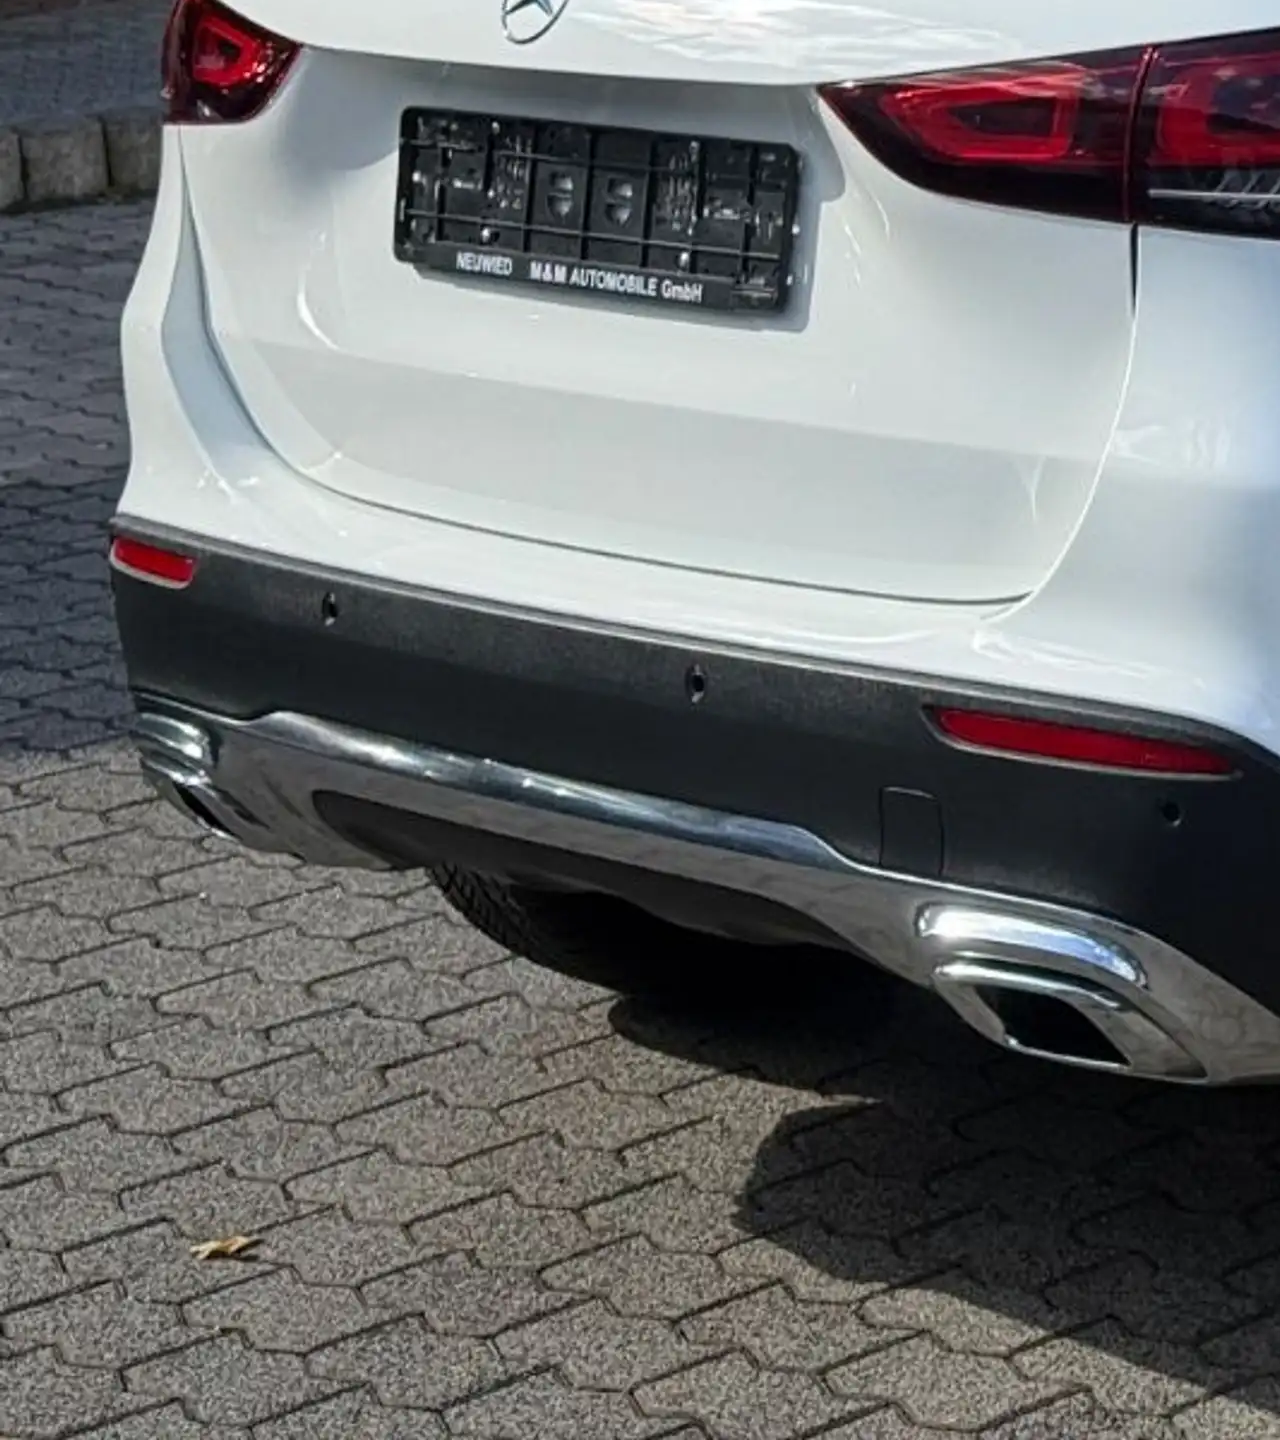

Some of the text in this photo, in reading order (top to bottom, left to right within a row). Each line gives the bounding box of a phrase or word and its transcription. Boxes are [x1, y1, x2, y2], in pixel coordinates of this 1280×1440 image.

[456, 251, 513, 277] NEUWIED
[569, 267, 658, 298] AUTOMOBILE
[660, 280, 703, 304] GmbH
